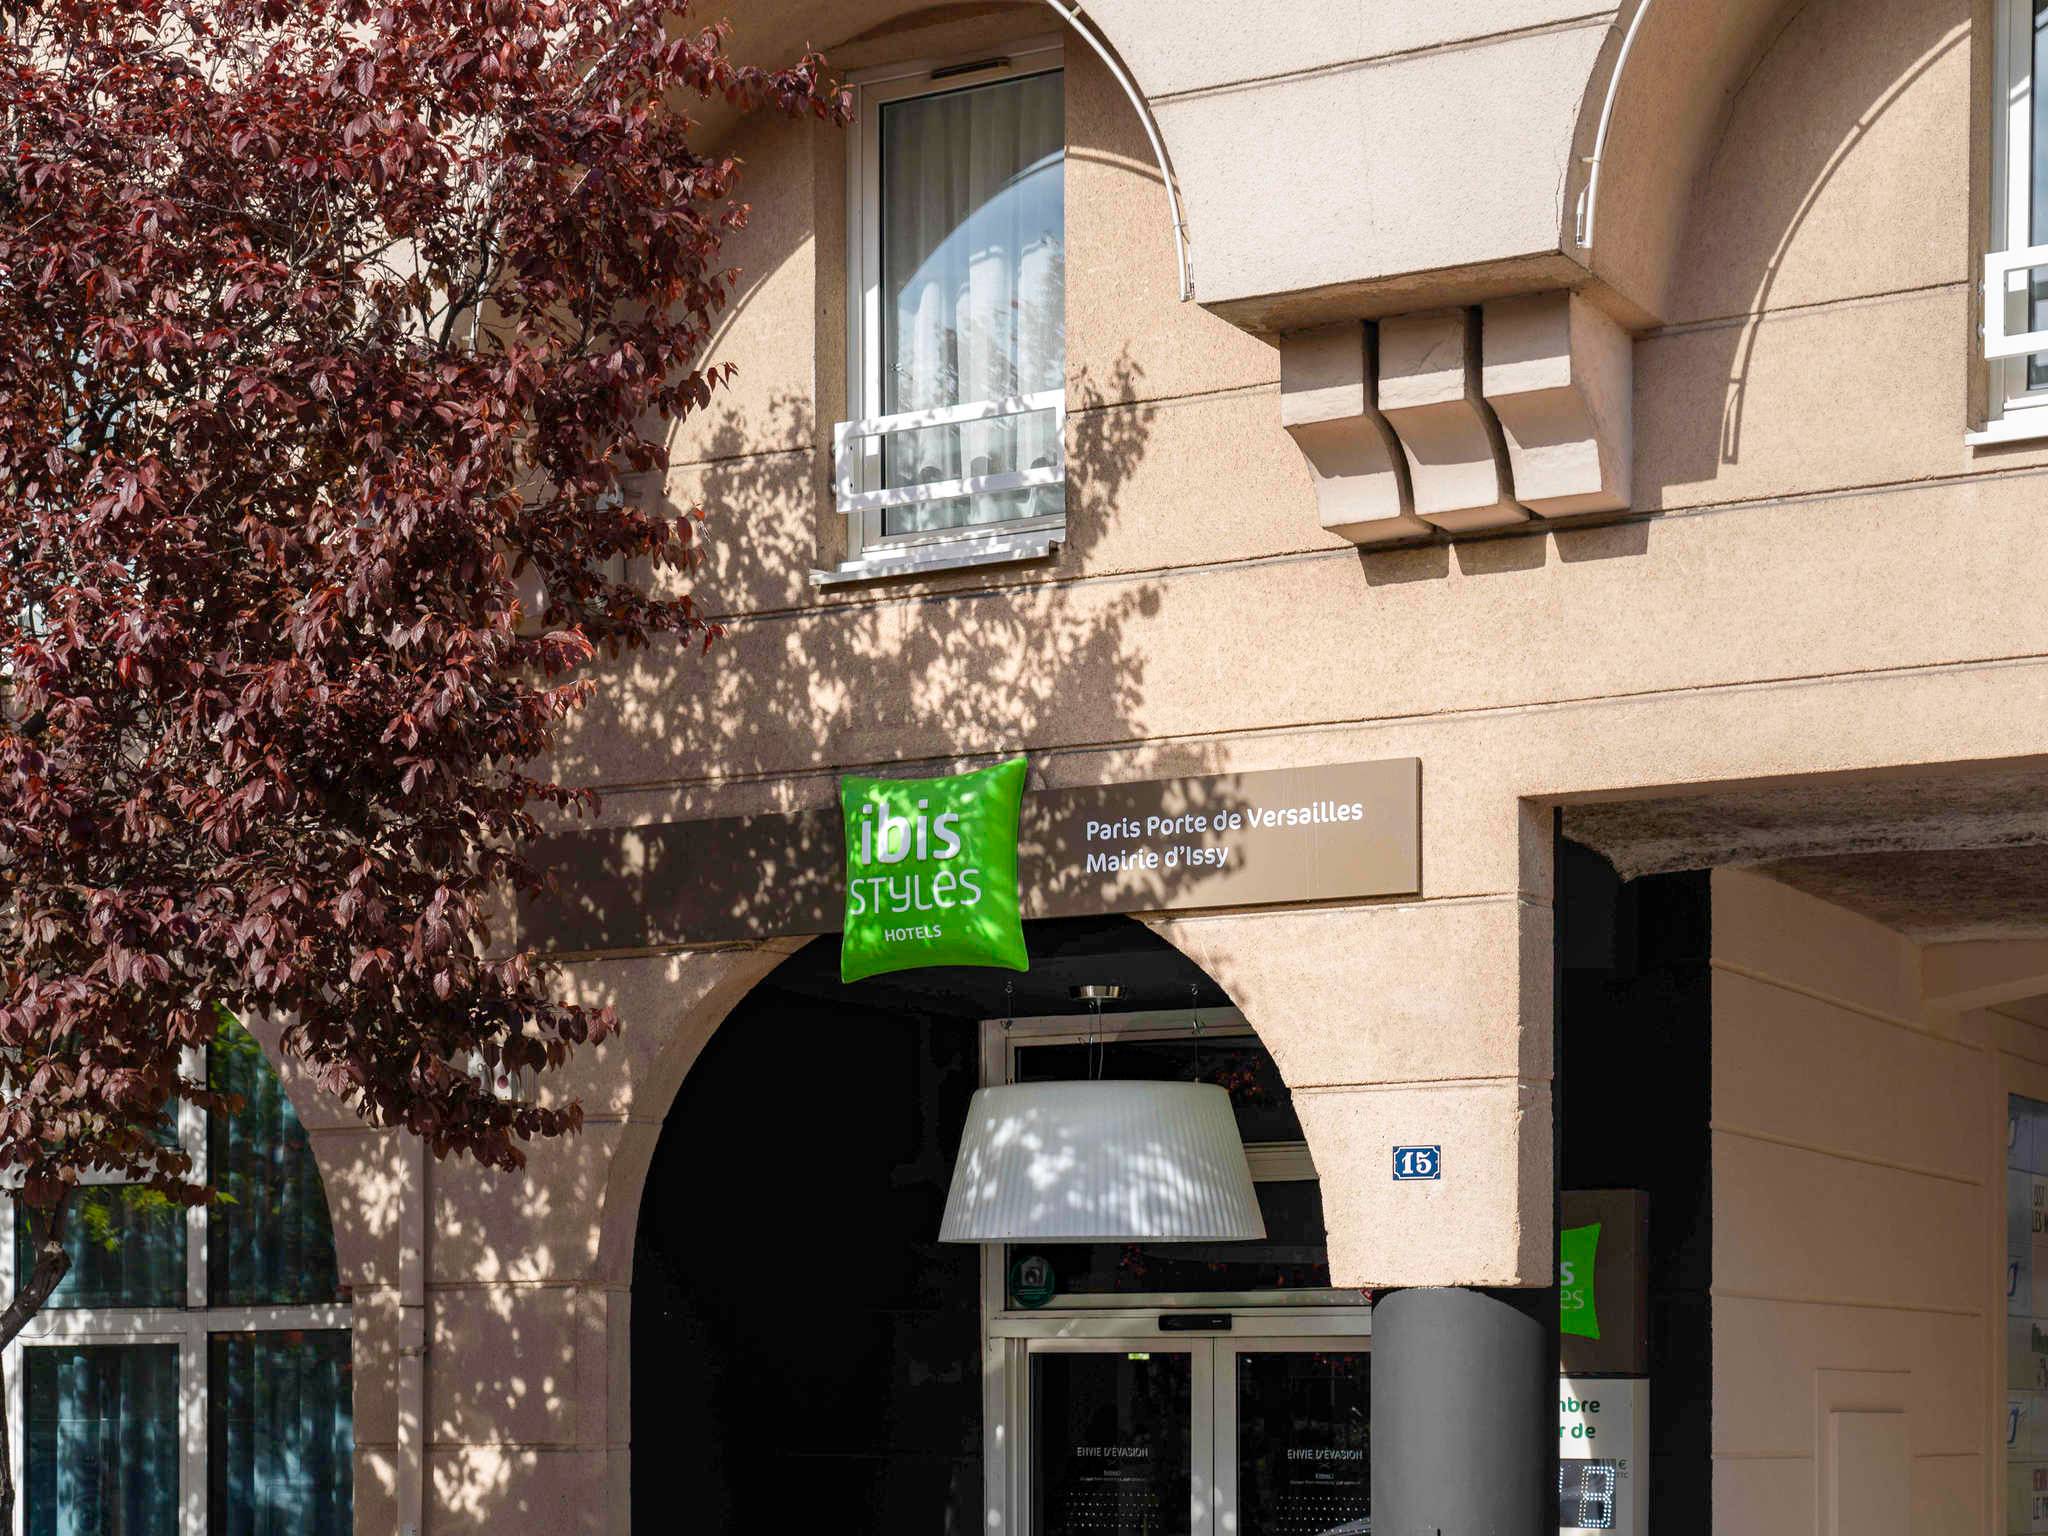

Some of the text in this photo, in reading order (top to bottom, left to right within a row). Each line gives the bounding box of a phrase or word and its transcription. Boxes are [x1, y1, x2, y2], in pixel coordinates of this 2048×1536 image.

[1086, 800, 1364, 841] Paris Porte de Versailles
[861, 798, 961, 865] ibis
[1086, 846, 1229, 873] Mairie d'Issy
[884, 924, 942, 942] HOTELS
[1400, 1151, 1433, 1175] 15
[1571, 1423, 1596, 1439] de
[1077, 1447, 1102, 1457] ENVIE
[1287, 1448, 1313, 1460] ENVIE
